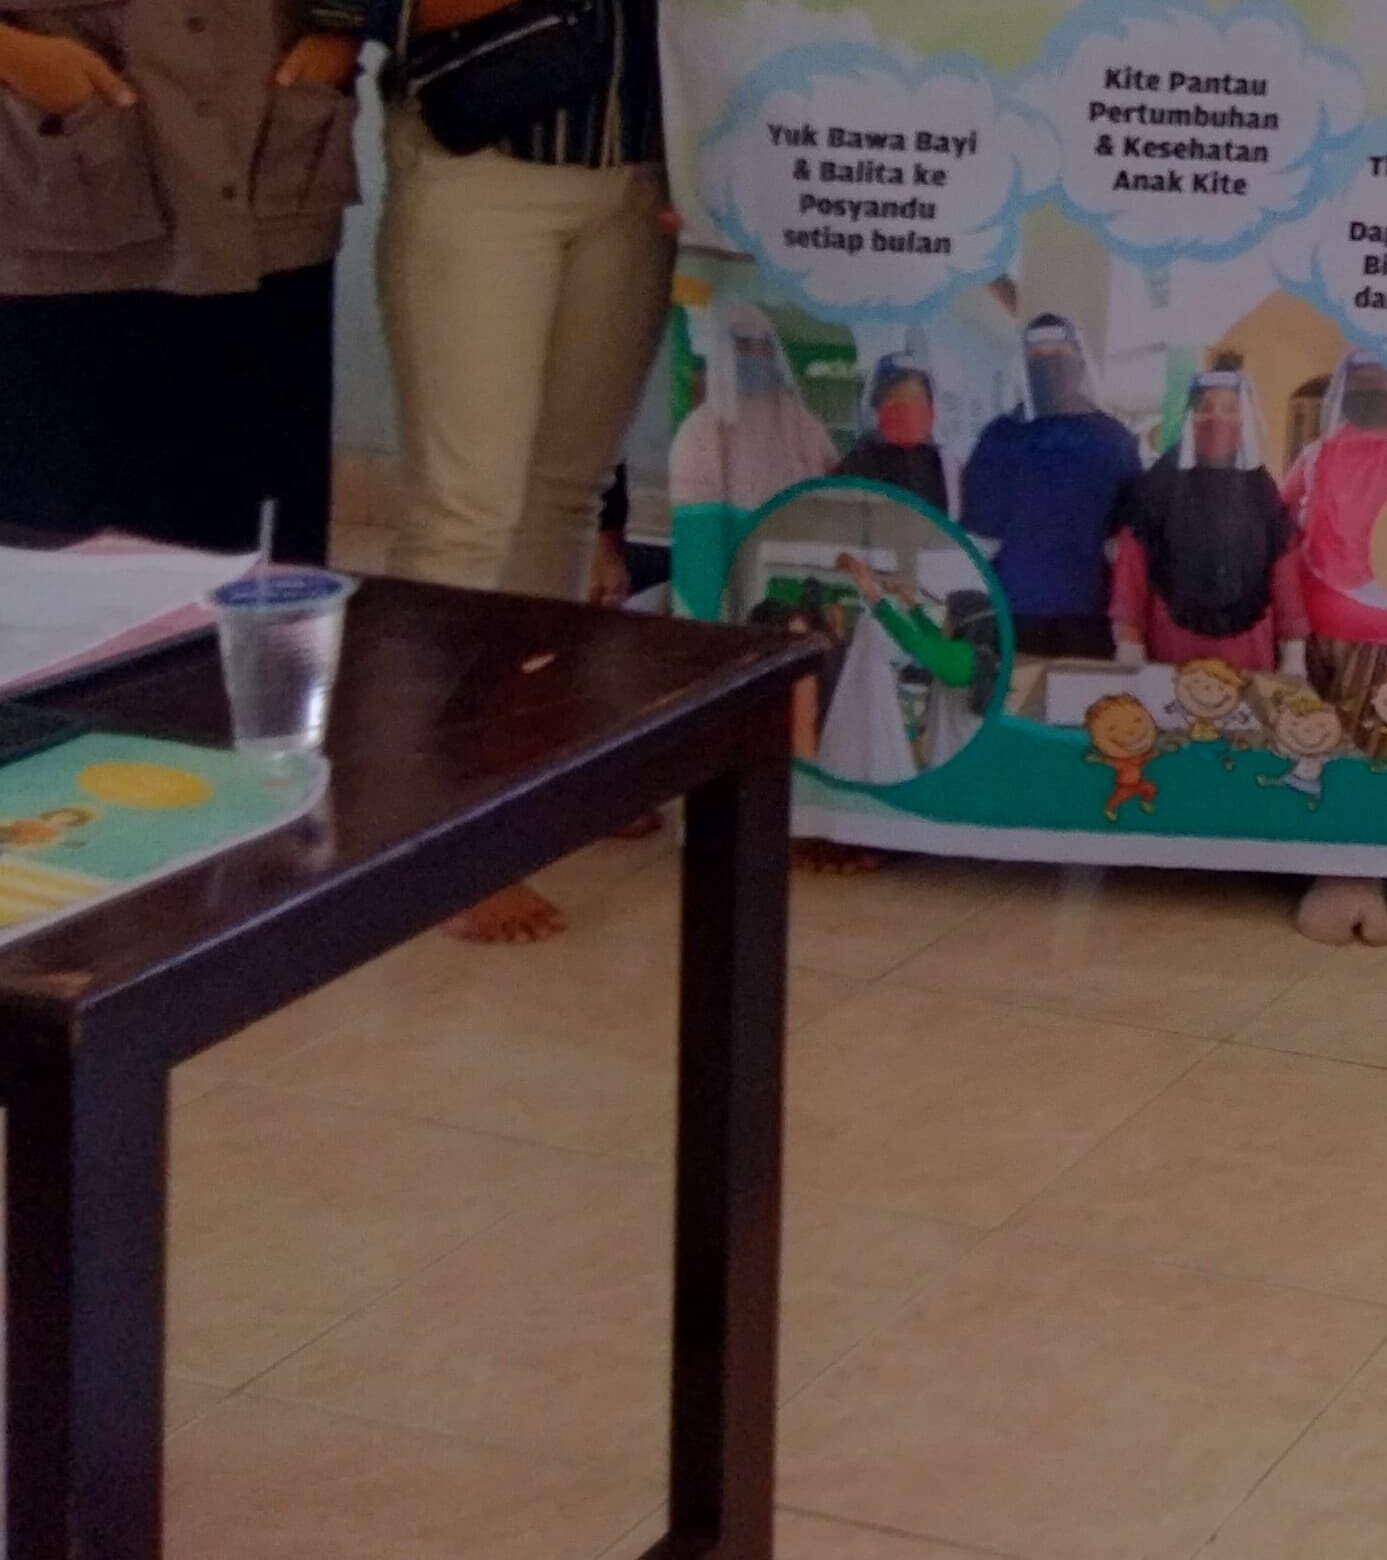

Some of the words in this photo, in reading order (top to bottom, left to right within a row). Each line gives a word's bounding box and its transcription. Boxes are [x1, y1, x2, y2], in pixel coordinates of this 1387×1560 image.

[1105, 66, 1161, 91] Kite
[1169, 71, 1267, 96] Pantau
[1089, 101, 1279, 130] Pertumbuhan
[767, 123, 818, 147] Yuk
[827, 127, 906, 151] Bawa
[914, 130, 977, 158] Bayi
[1095, 134, 1114, 156] &
[1123, 136, 1268, 163] Kesehatan
[793, 158, 811, 181] &
[819, 160, 904, 185] Balita
[913, 163, 948, 187] ke
[1113, 170, 1182, 193] Anak
[1192, 170, 1247, 196] Kite
[799, 193, 936, 223] Posyandu
[783, 226, 864, 256] setiap
[871, 229, 952, 255] bulan
